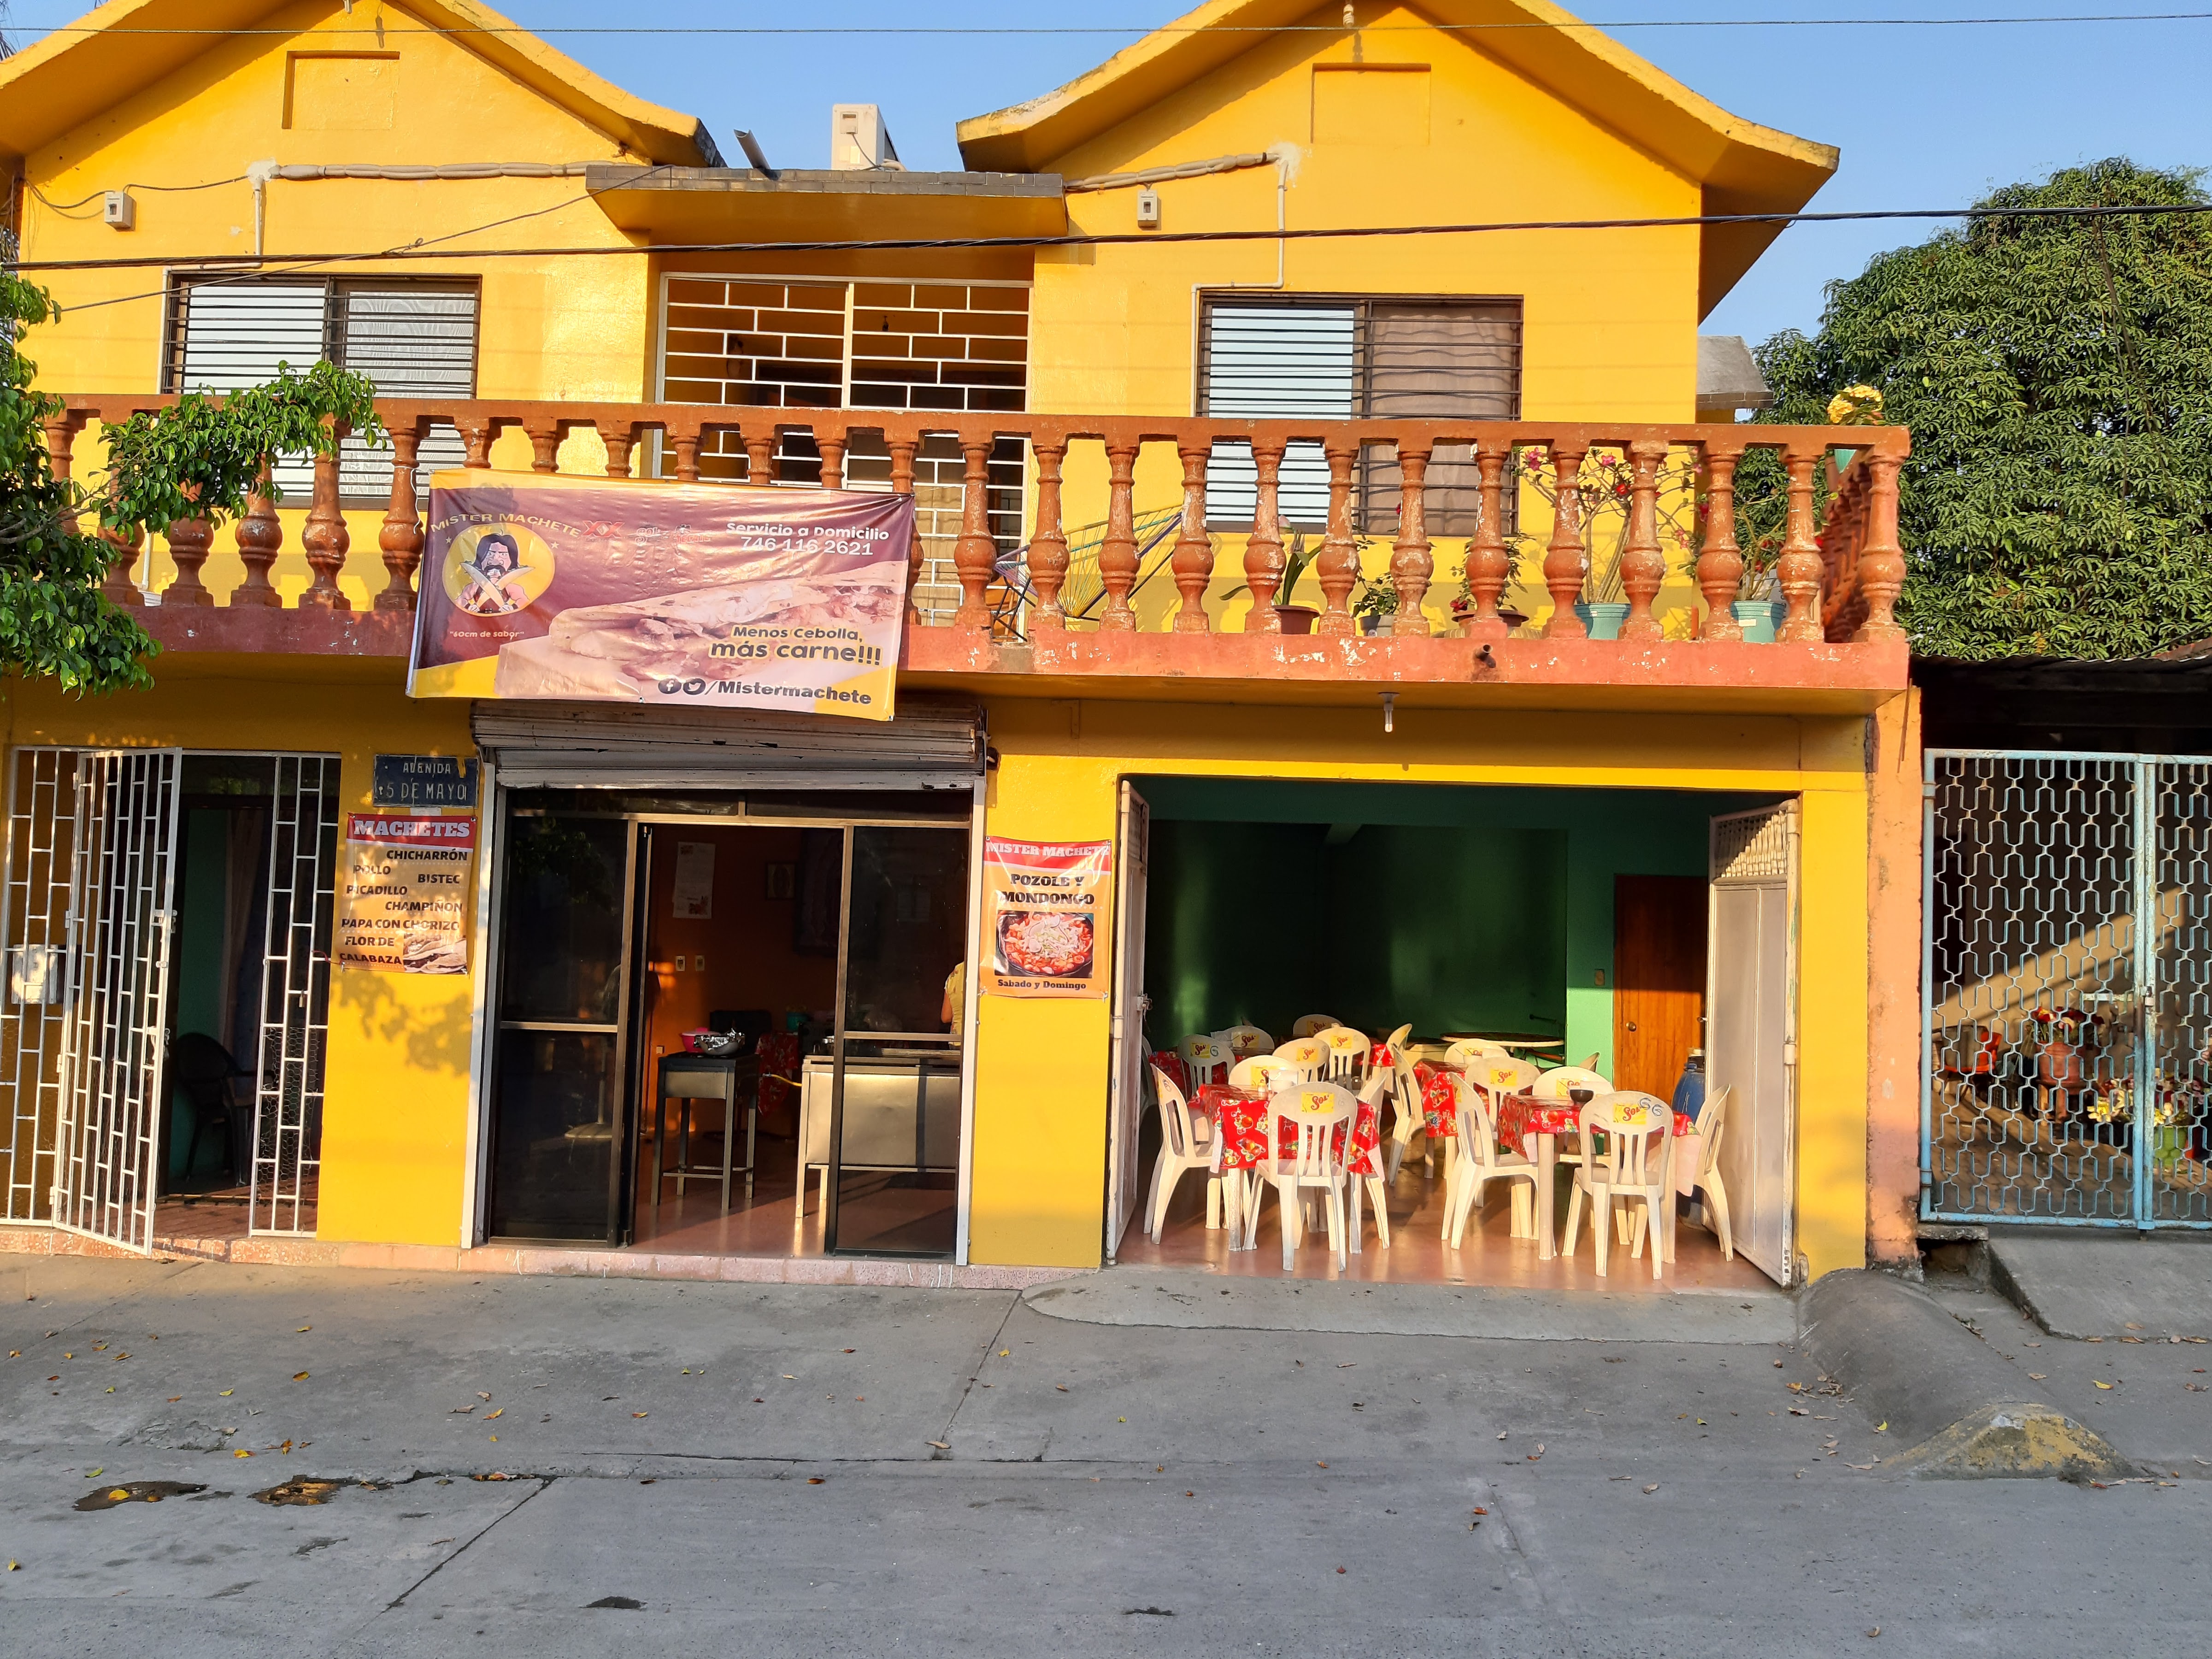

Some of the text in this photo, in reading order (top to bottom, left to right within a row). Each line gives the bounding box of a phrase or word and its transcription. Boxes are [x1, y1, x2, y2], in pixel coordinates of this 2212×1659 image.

[430, 513, 582, 538] MISTER MACHETE
[726, 523, 889, 540] Servicio a Domicilio
[741, 536, 873, 556] 746 116 2621
[733, 626, 863, 643] Menos Cebolla,
[711, 640, 881, 665] más carne!!!
[403, 763, 451, 774] AVENIDA
[401, 782, 419, 799] DE
[426, 783, 466, 800] MAYO
[353, 819, 470, 838] MACHETES
[386, 848, 467, 860] CHICHARRÓN
[985, 842, 1040, 856] MISTER
[353, 865, 391, 875] POLLO
[418, 874, 460, 884] BISTEC
[1011, 874, 1085, 886] POZOLE Y
[346, 885, 408, 895] PICADILLO
[1002, 891, 1095, 905] MONDONGO
[341, 918, 459, 930] PAPA CON CHORIZO
[345, 936, 395, 946] FLOR DE
[340, 953, 402, 965] CALABAZA
[998, 979, 1032, 988] Sabado
[1043, 981, 1087, 990] Domingo
